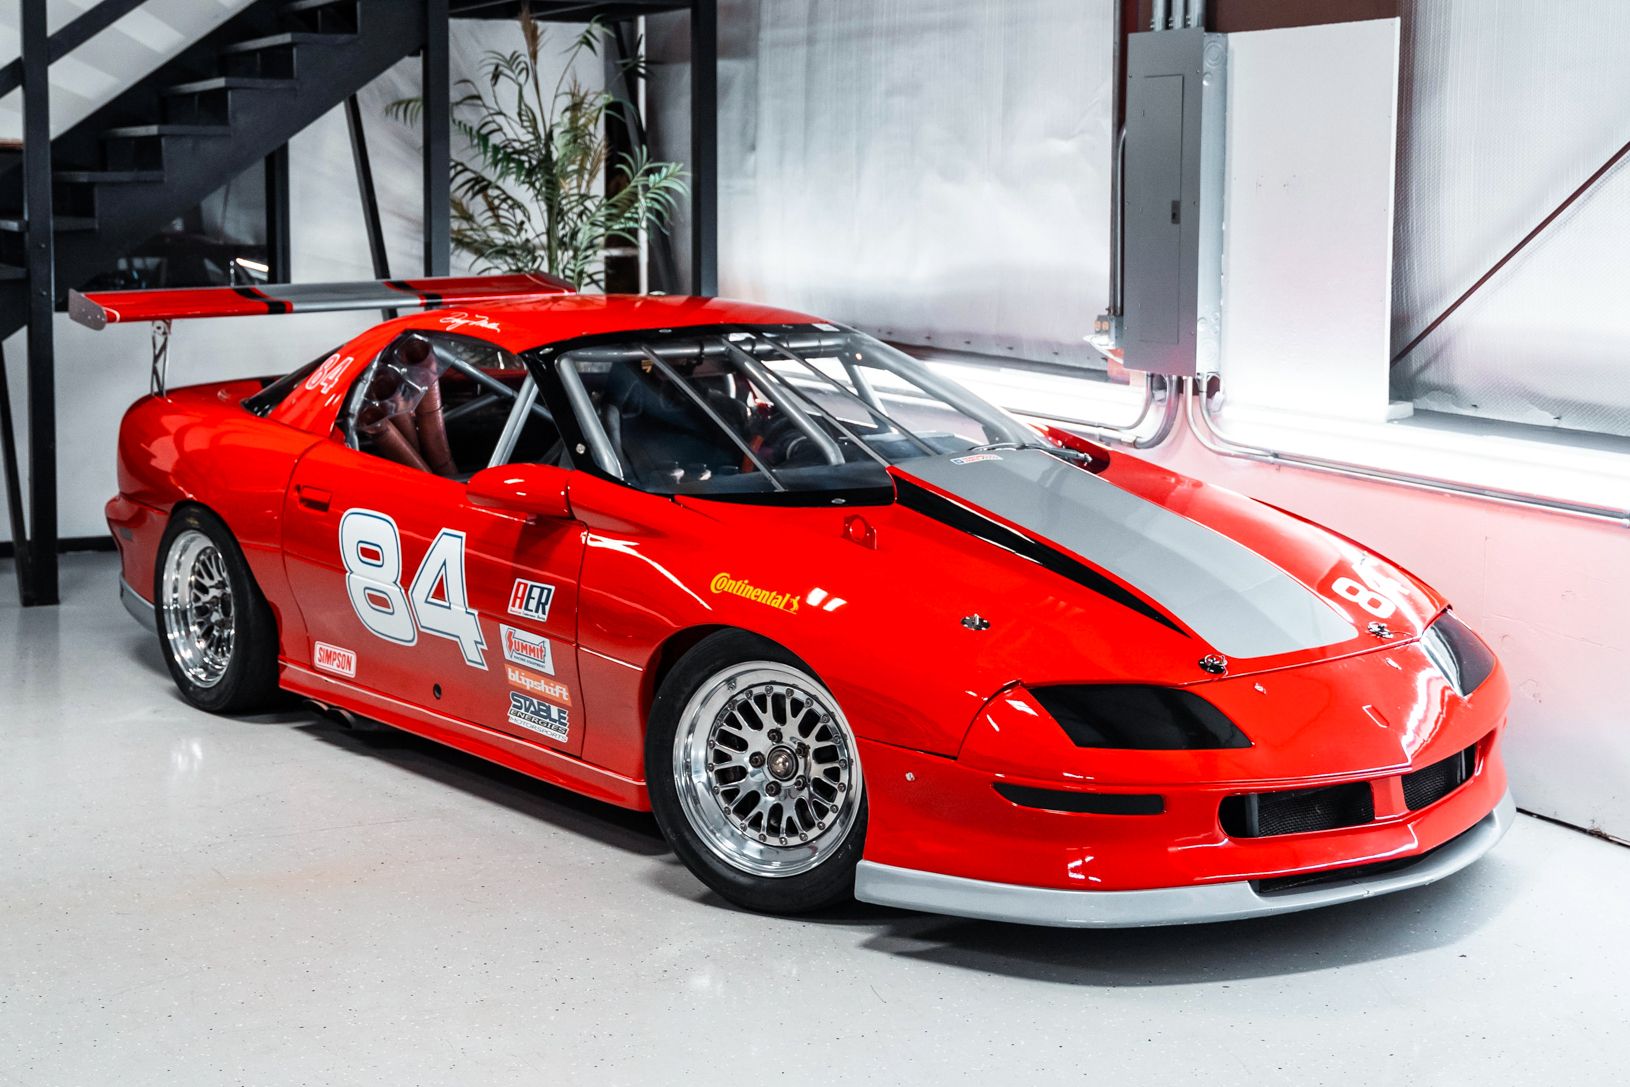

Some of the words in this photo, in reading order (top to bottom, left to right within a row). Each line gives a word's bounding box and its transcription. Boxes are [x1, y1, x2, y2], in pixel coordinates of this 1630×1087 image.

[304, 353, 355, 395] 84
[338, 507, 489, 671] 84
[511, 581, 553, 616] AER
[709, 572, 791, 610] Continental
[317, 646, 354, 672] SIMPSON
[507, 667, 569, 701] blipshift
[509, 709, 567, 735] ENERGIES
[510, 691, 568, 728] STABLE
[509, 716, 568, 742] MOTORSPORTS
